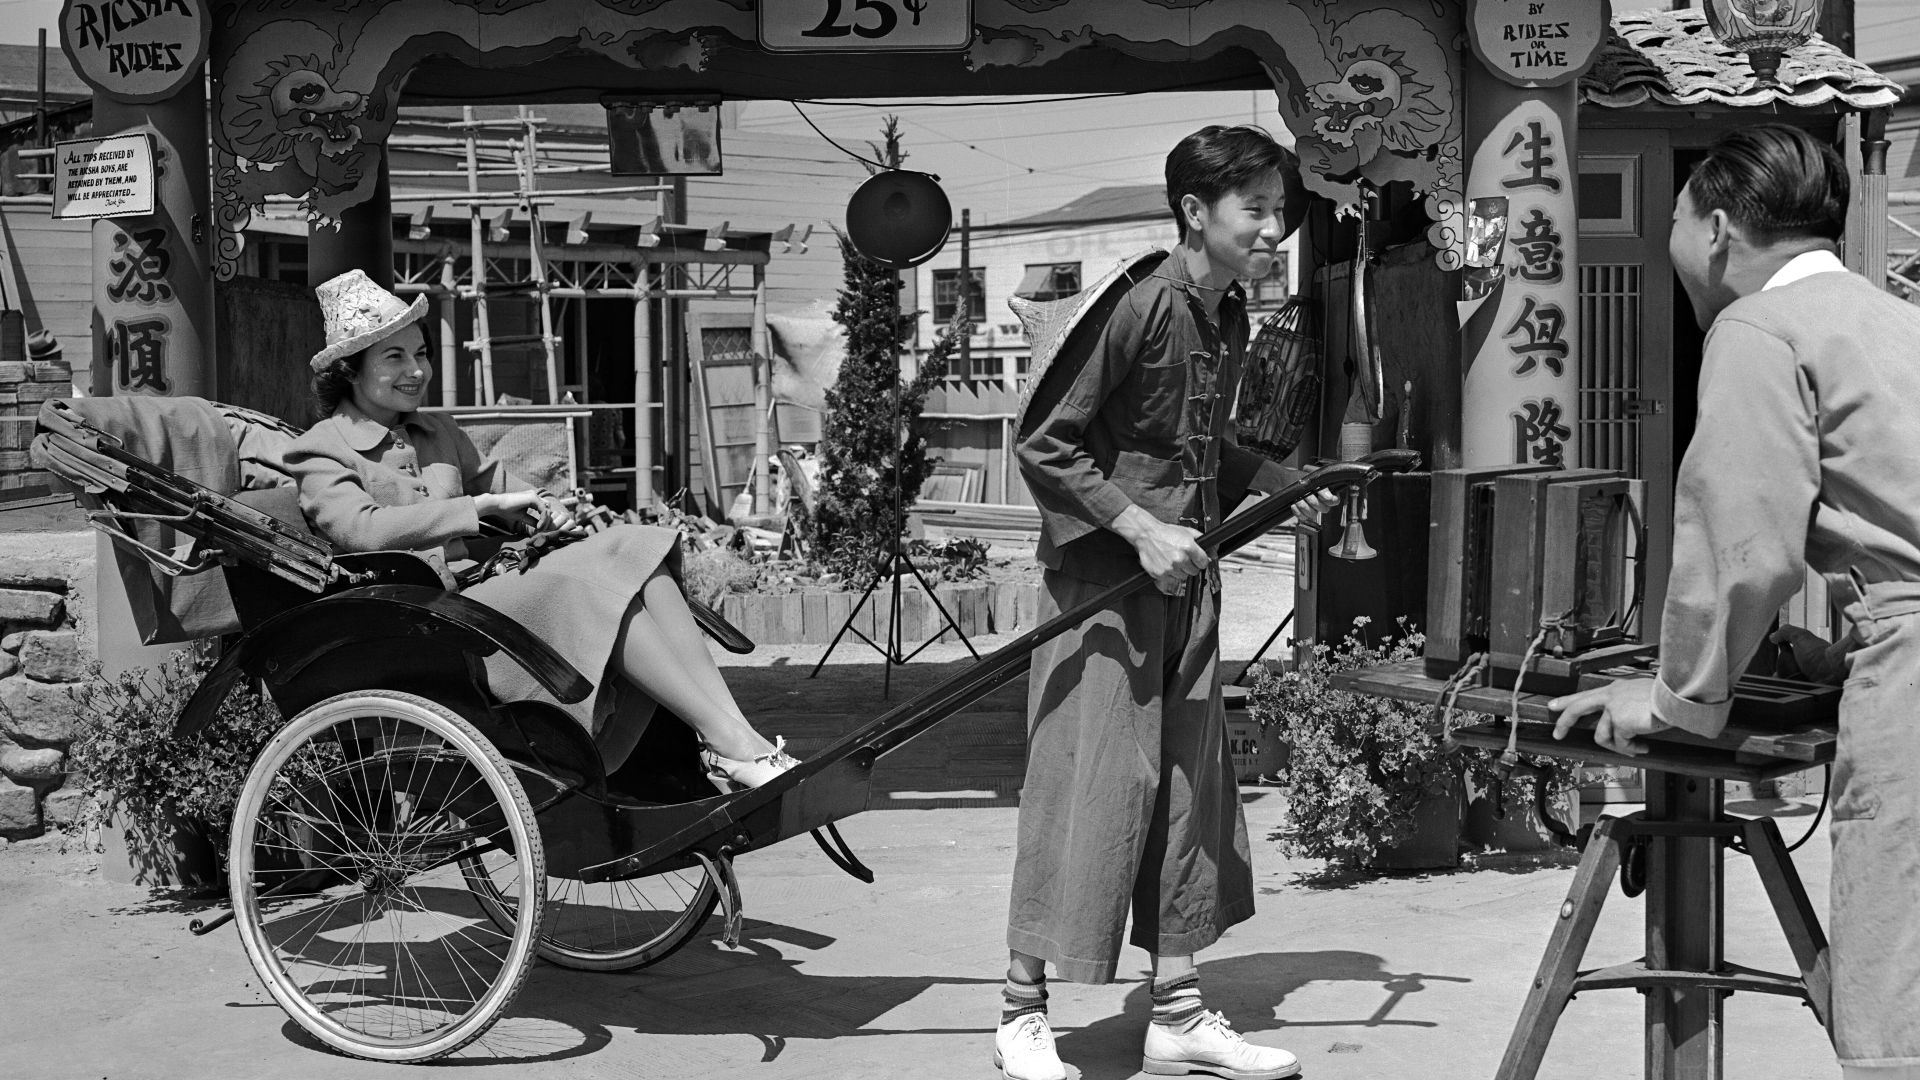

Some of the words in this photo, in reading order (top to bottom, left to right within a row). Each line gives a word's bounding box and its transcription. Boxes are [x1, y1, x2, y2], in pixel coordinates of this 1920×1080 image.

[1528, 3, 1545, 15] BY
[1503, 22, 1570, 41] RIDES
[1530, 40, 1547, 49] OR
[106, 41, 184, 78] RIDES
[1510, 50, 1568, 68] TIME
[64, 151, 81, 164] ALL
[83, 153, 98, 163] TIPS
[99, 150, 125, 161] RECEIVED
[126, 149, 135, 158] BY
[68, 168, 79, 176] THE
[117, 163, 128, 172] ARE
[68, 179, 95, 189] RETAINED
[95, 178, 104, 187] BY
[124, 175, 137, 184] AND
[68, 193, 81, 201] WILL
[83, 192, 90, 200] BE
[107, 133, 171, 393] 源順
